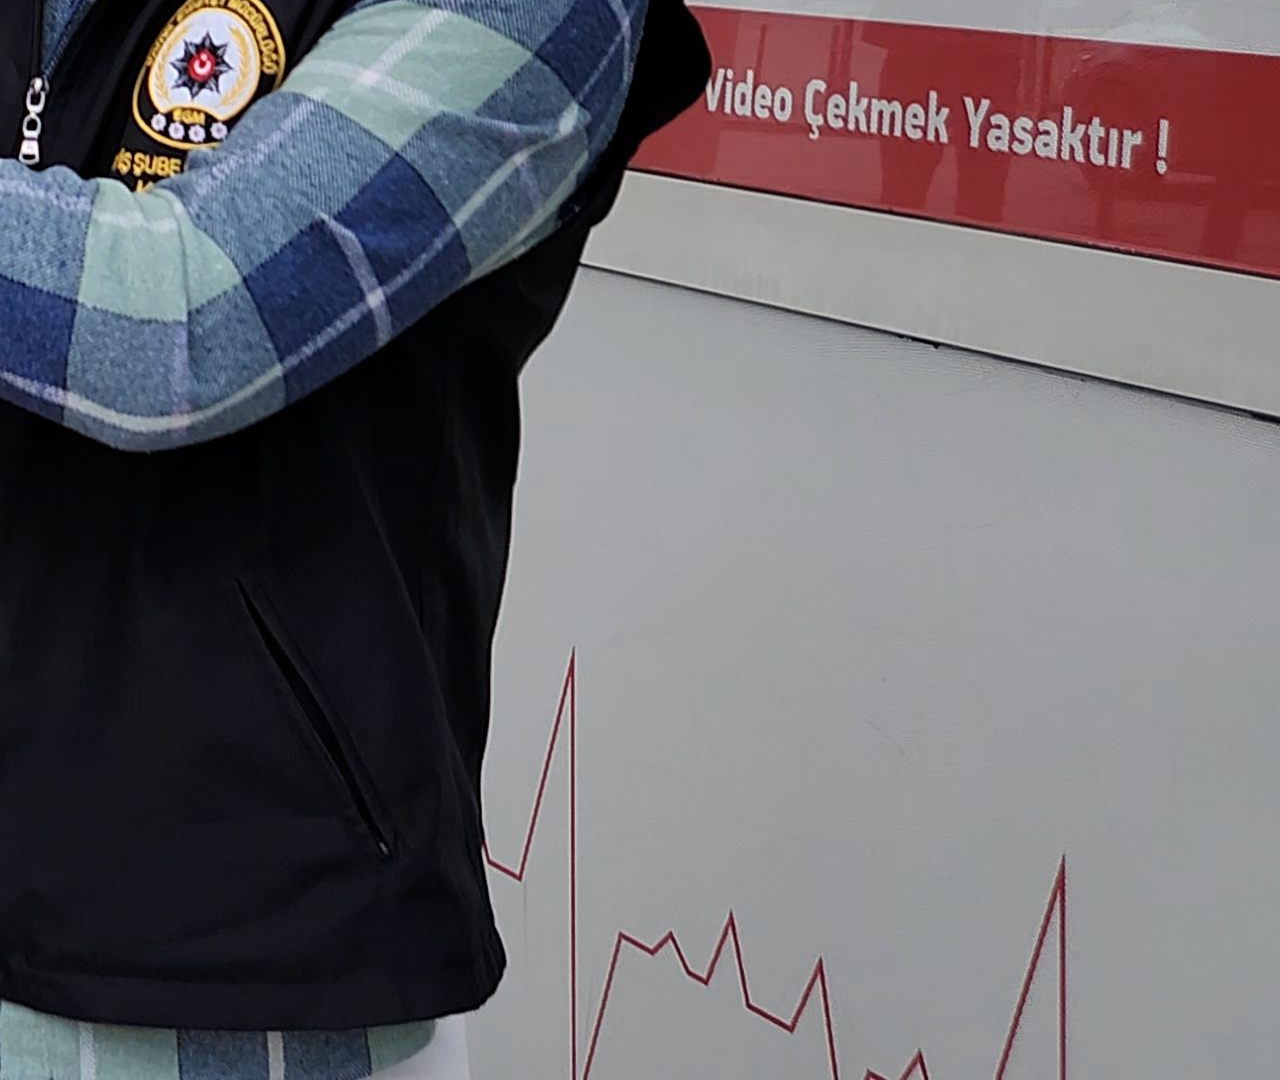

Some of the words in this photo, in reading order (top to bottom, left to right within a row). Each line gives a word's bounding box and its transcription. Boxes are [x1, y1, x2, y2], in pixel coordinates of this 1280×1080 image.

[704, 67, 794, 122] Video
[803, 78, 951, 141] Çekmek
[961, 95, 1143, 171] Yasaktır
[132, 151, 182, 177] ŞUBE
